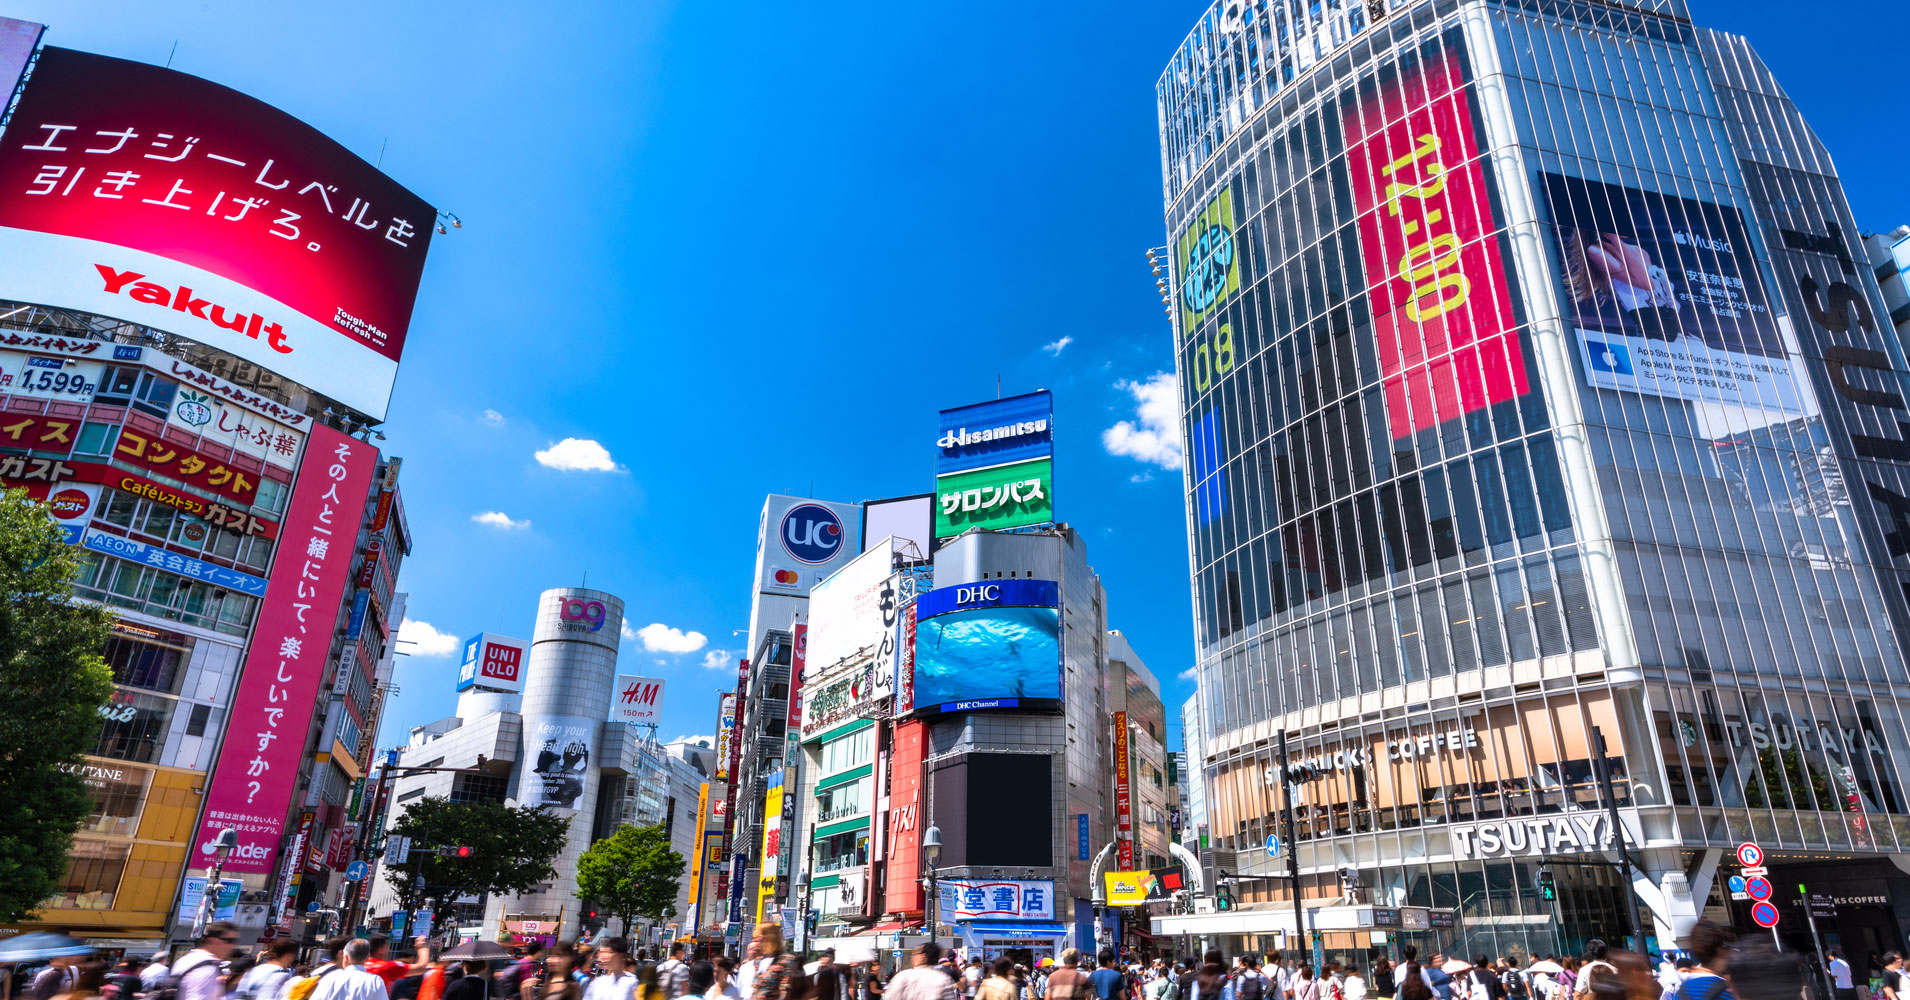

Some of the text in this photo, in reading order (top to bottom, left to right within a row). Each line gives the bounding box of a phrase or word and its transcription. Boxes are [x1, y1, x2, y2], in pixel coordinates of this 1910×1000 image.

[22, 124, 415, 248] エナジーレベルを
[26, 165, 321, 252] 引き上げろ。
[1685, 231, 1734, 254] Music
[1686, 270, 1744, 289] 安室奈美恵
[94, 263, 294, 354] Yakult
[333, 314, 371, 340] Refresh
[336, 306, 388, 340] Tough-Man
[1192, 322, 1235, 393] 08
[1637, 346, 1655, 358] App
[1655, 348, 1678, 360] Store
[1679, 352, 1686, 361] &
[1640, 358, 1664, 370] Apple
[22, 368, 95, 396] 1,599円
[172, 360, 306, 425] しゃぶしゃぶバイキング
[218, 409, 297, 457] しゃぶ葉
[937, 418, 1047, 448] Hisamitsu
[0, 456, 74, 481] ガスト
[117, 430, 253, 495] コンタクト
[55, 501, 85, 512] ガスト
[940, 477, 1045, 515] サロンパス
[204, 503, 265, 536] ガスト
[93, 534, 138, 556] AEON
[788, 517, 840, 549] UC
[362, 560, 374, 583] ガスト
[956, 585, 1000, 605] DHC
[557, 622, 588, 632] SHIBUYA
[558, 596, 606, 633] 109
[875, 580, 897, 692] もんじゃ
[466, 641, 478, 663] THE
[489, 647, 516, 663] UNI
[335, 649, 353, 691] 渋谷駅前ビル
[486, 662, 515, 677] QLO
[621, 681, 660, 707] H&M
[956, 699, 999, 710] DHC Channel
[623, 709, 645, 718] 150m
[537, 721, 587, 738] Keep your
[1727, 721, 1885, 756] TSUTAYA
[534, 738, 586, 757] Head High.
[1389, 728, 1478, 760] COFFEE
[58, 762, 123, 781] CCITANE
[1117, 714, 1130, 825] クスリのことなら 三千里
[210, 810, 281, 826] 普通は出会わない人と、
[1454, 814, 1634, 855] TSUTAYA
[229, 842, 272, 860] nder
[1848, 896, 1887, 905] COFFEE
